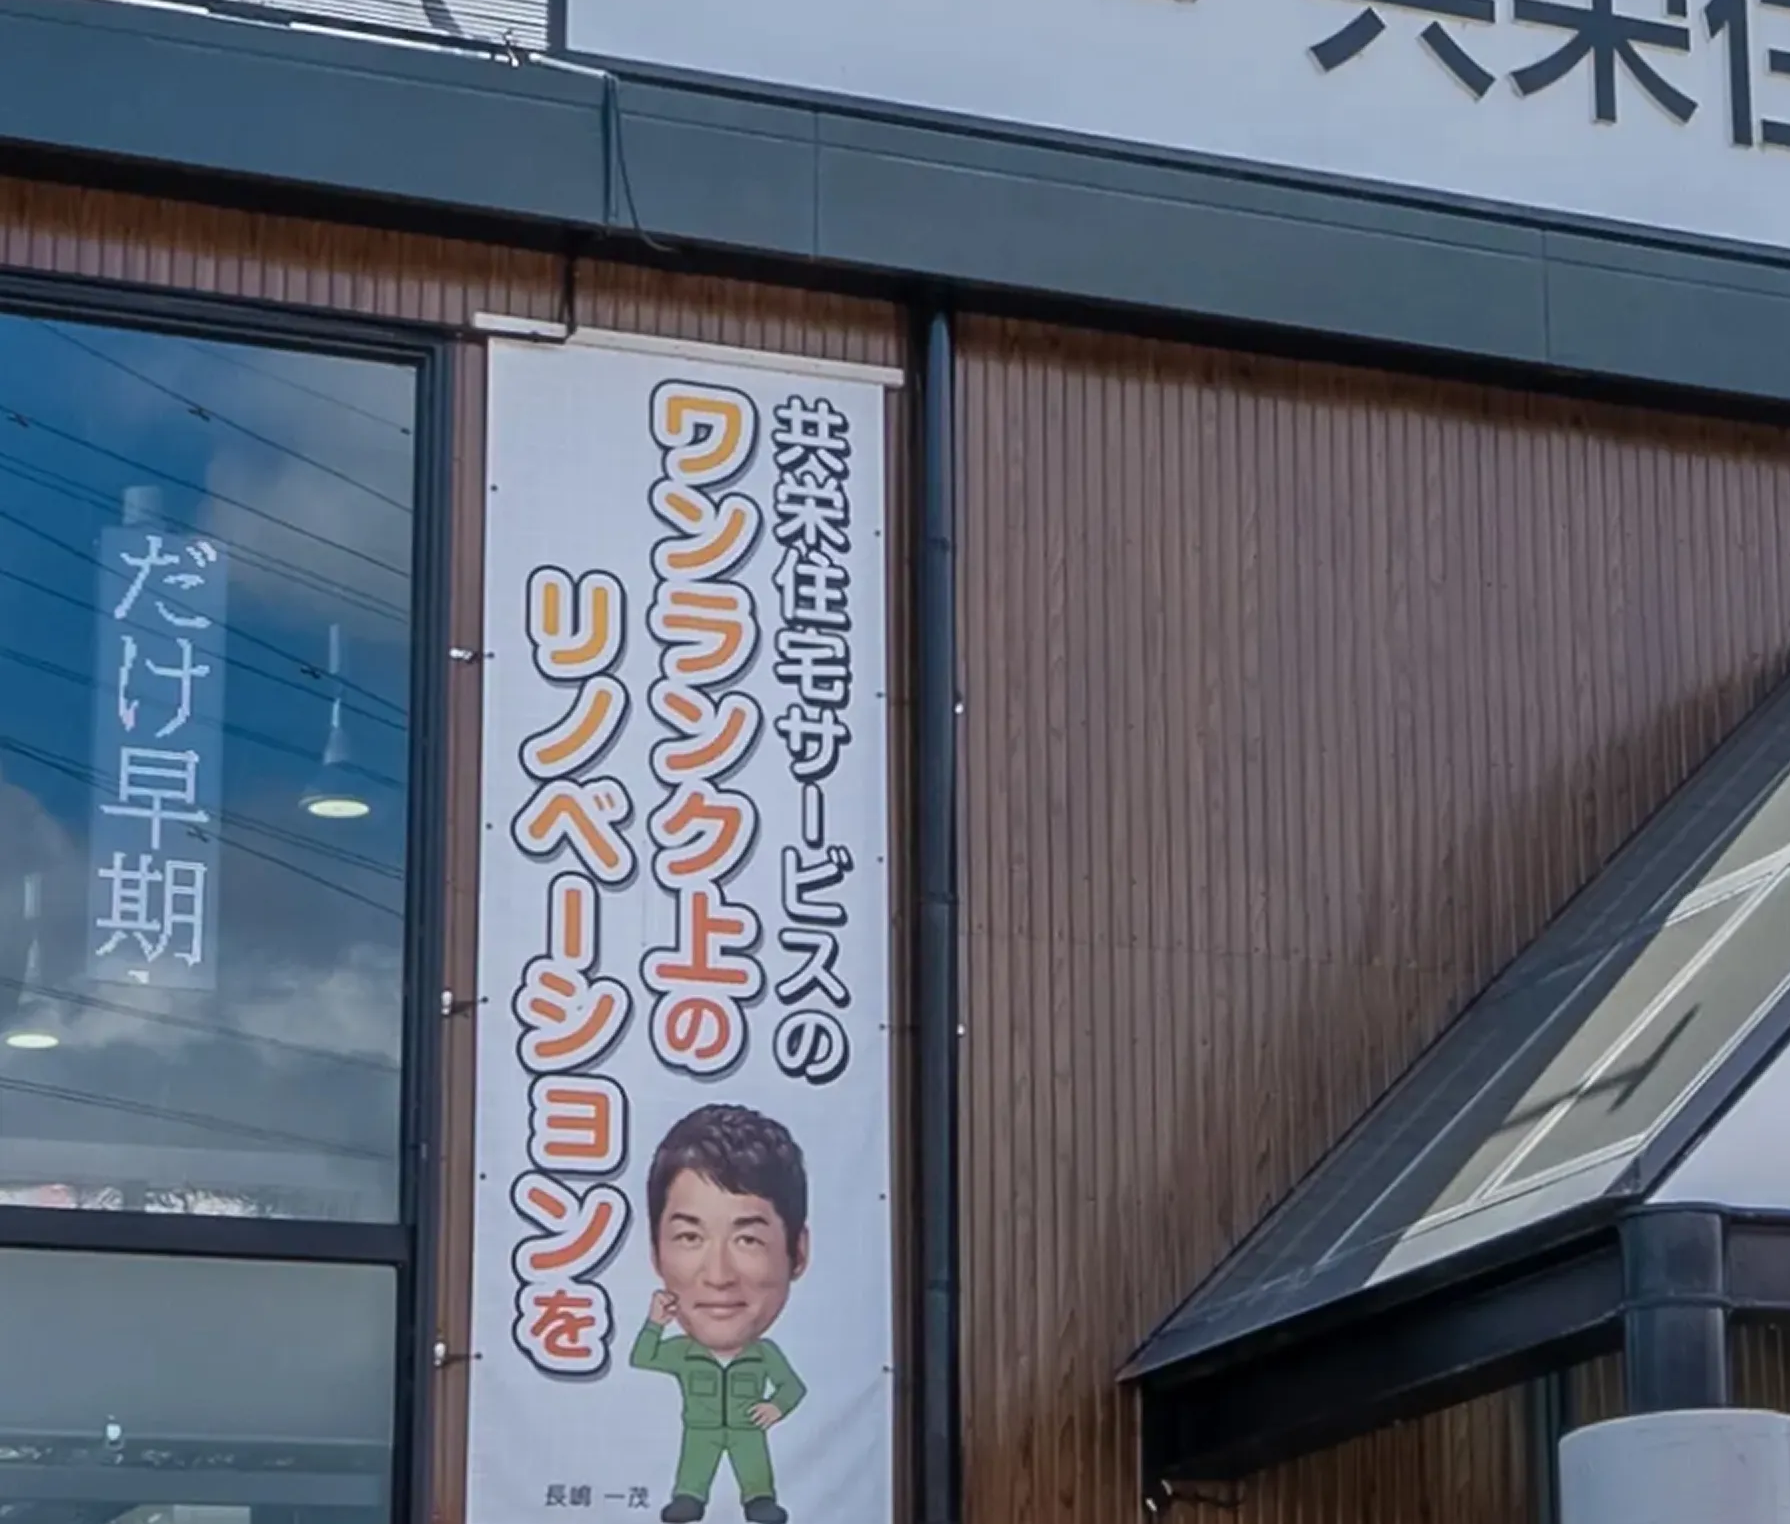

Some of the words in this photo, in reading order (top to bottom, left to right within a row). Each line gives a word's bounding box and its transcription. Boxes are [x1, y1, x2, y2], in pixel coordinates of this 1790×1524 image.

[93, 535, 218, 983] だけ早期
[511, 565, 636, 1380] リノベーションを
[644, 379, 763, 1075] ワンランク上の
[772, 394, 851, 1079] 共栄住宅サービスの
